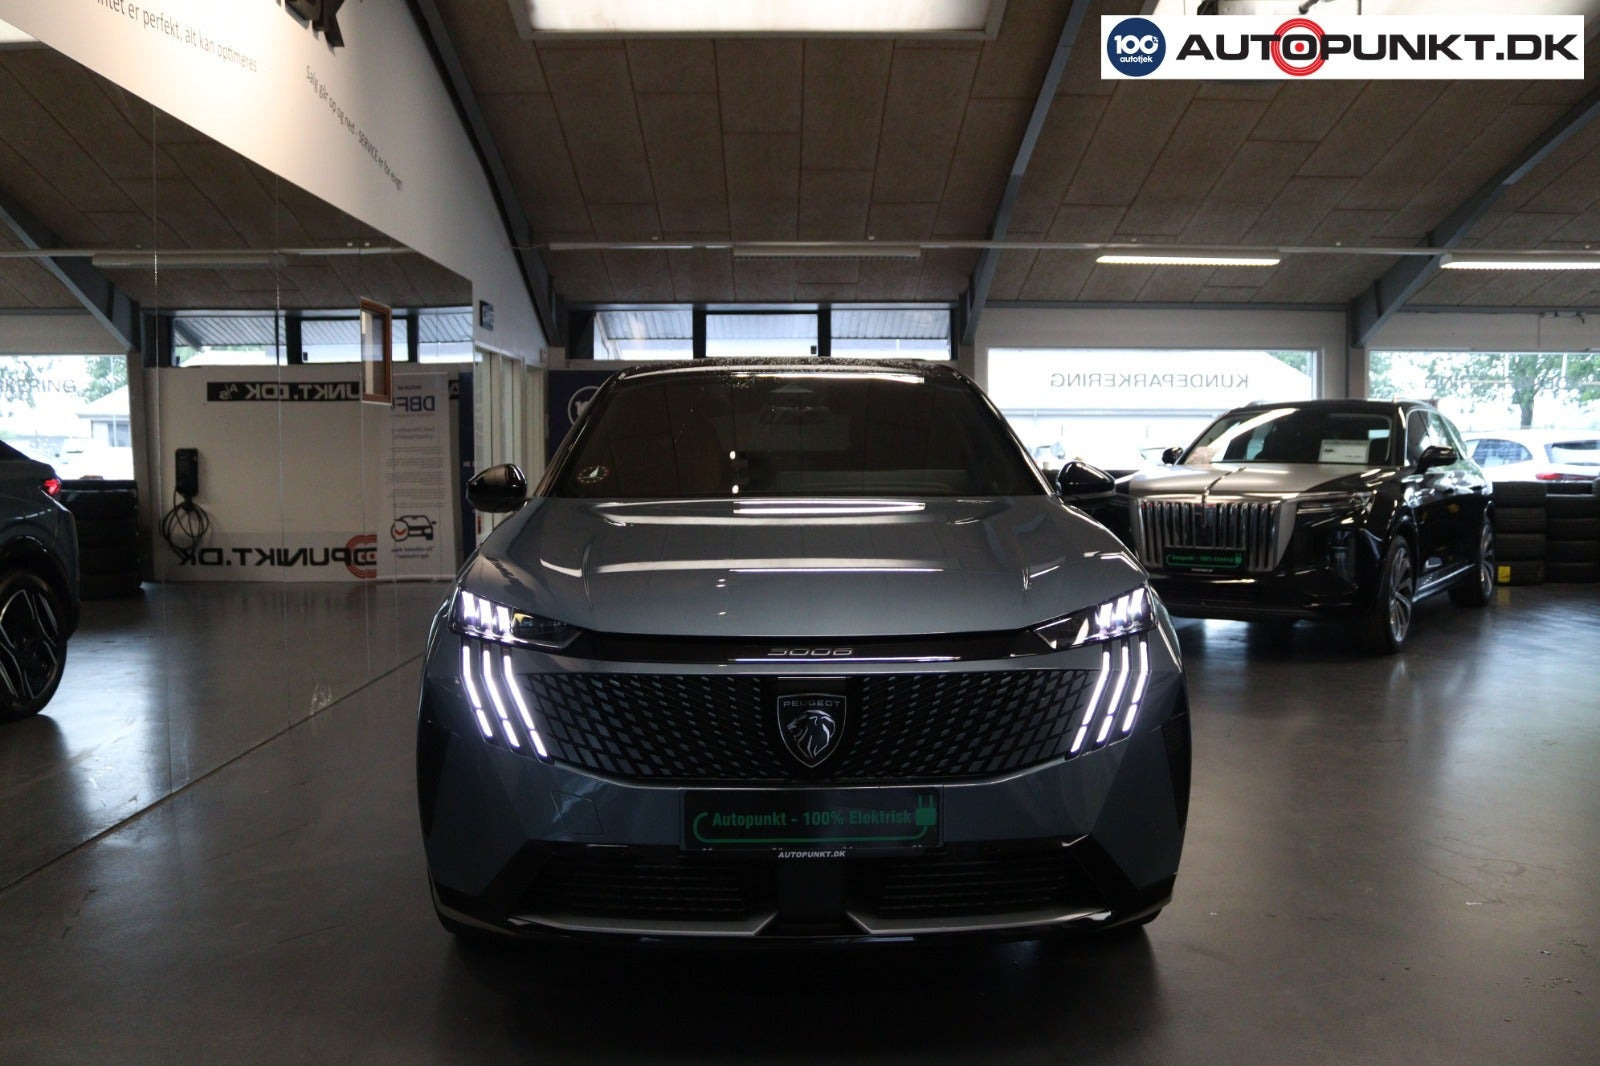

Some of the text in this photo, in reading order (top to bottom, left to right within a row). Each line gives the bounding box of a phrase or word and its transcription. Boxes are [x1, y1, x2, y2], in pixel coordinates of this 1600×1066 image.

[128, 3, 140, 21] er
[143, 10, 183, 45] perfekt,
[185, 25, 198, 47] alt
[199, 29, 215, 54] kan
[217, 42, 258, 73] optimeres
[712, 811, 787, 830] Autopunkt
[803, 811, 844, 826] 100%
[849, 809, 912, 825] Elektrisk
[777, 850, 846, 859] AUTOPUNKT.DK
